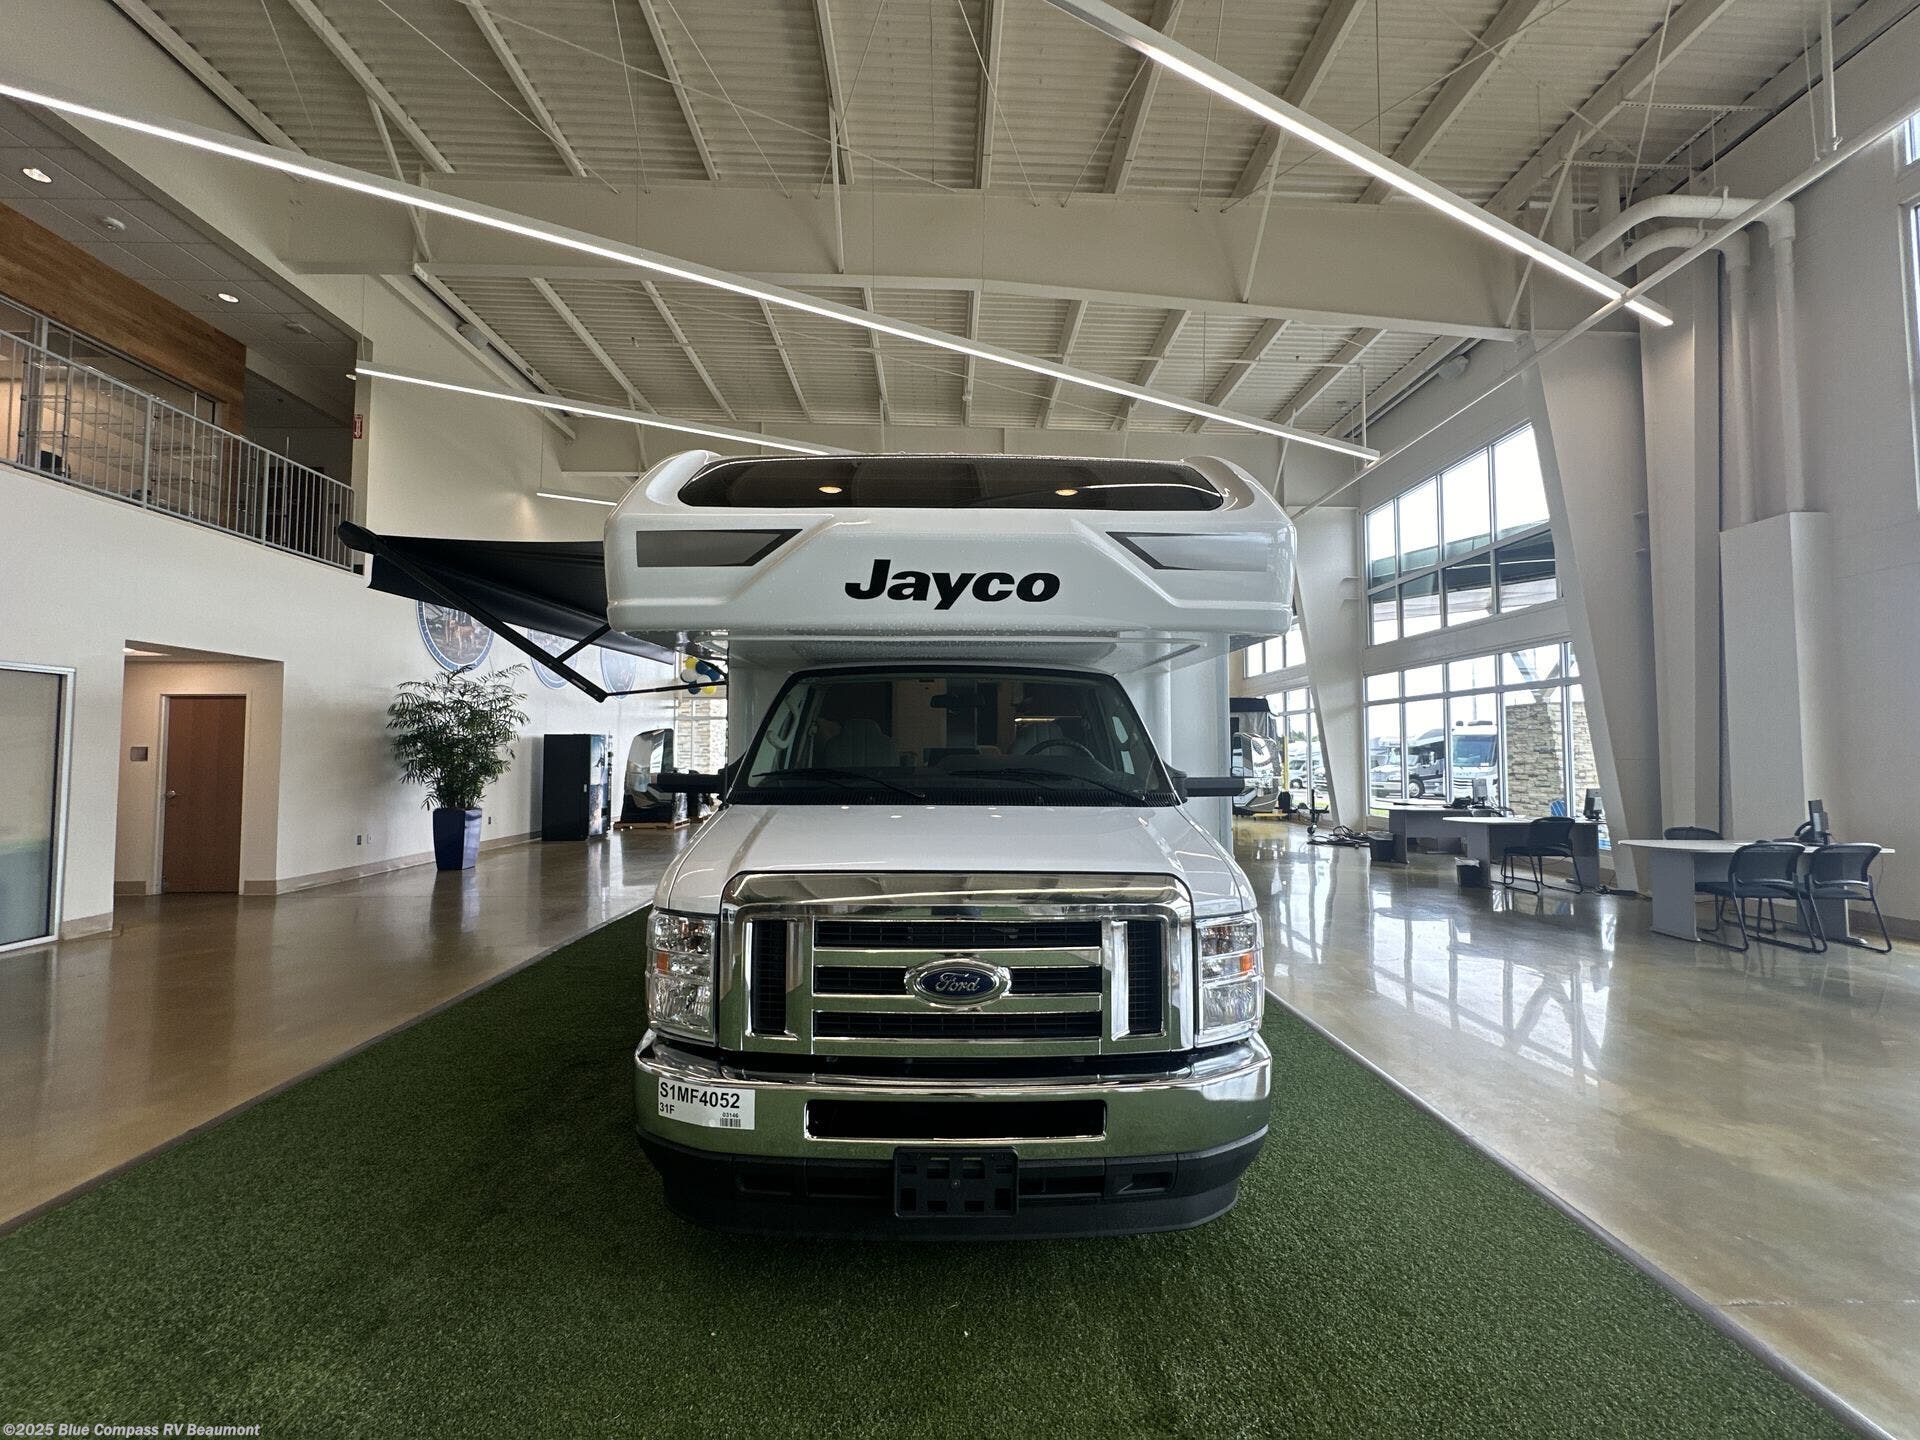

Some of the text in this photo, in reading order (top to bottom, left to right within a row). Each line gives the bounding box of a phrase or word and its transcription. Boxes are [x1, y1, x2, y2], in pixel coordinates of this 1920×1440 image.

[845, 559, 1060, 610] Jayco
[935, 972, 981, 992] Ford
[660, 1082, 740, 1109] S1MF4052
[659, 1102, 675, 1115] 31F
